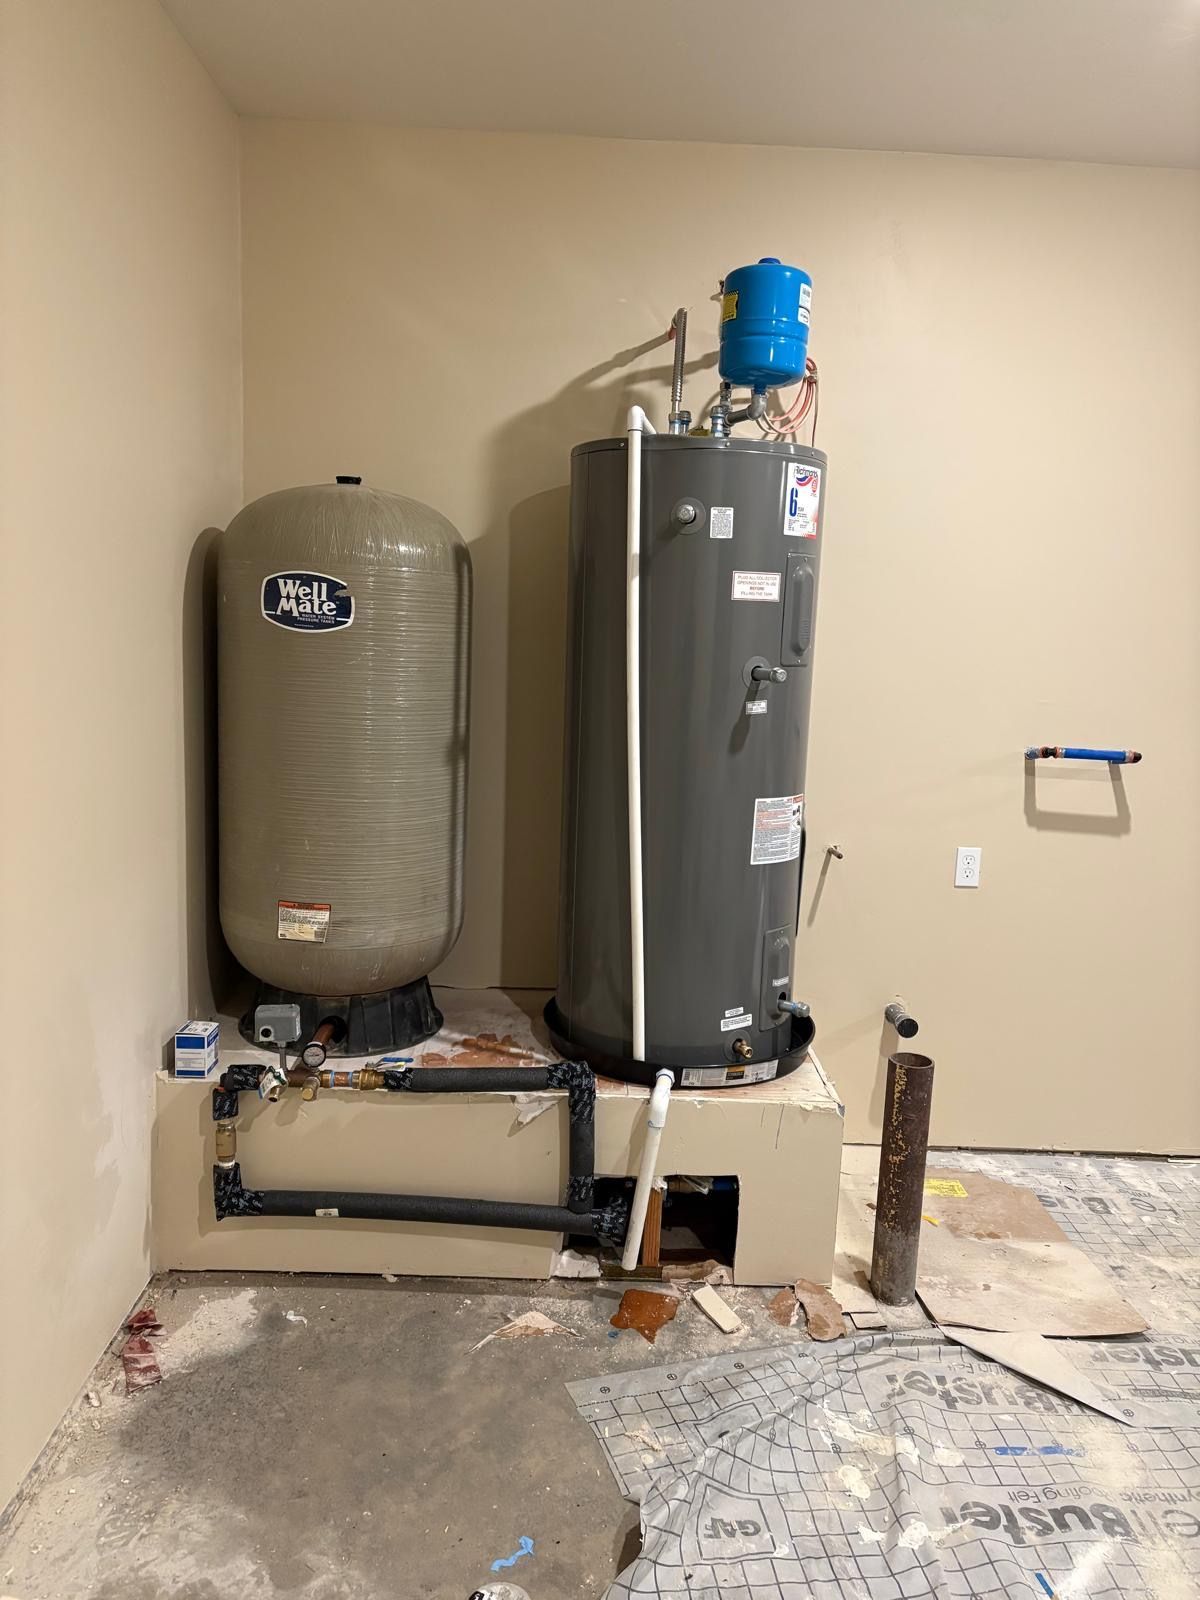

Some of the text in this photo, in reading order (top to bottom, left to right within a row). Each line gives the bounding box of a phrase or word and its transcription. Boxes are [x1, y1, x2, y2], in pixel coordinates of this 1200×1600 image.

[789, 487, 798, 517] 6
[277, 578, 328, 601] Well
[276, 597, 337, 617] Mate
[1008, 1488, 1041, 1504] Felt
[704, 1517, 761, 1539] GAF
